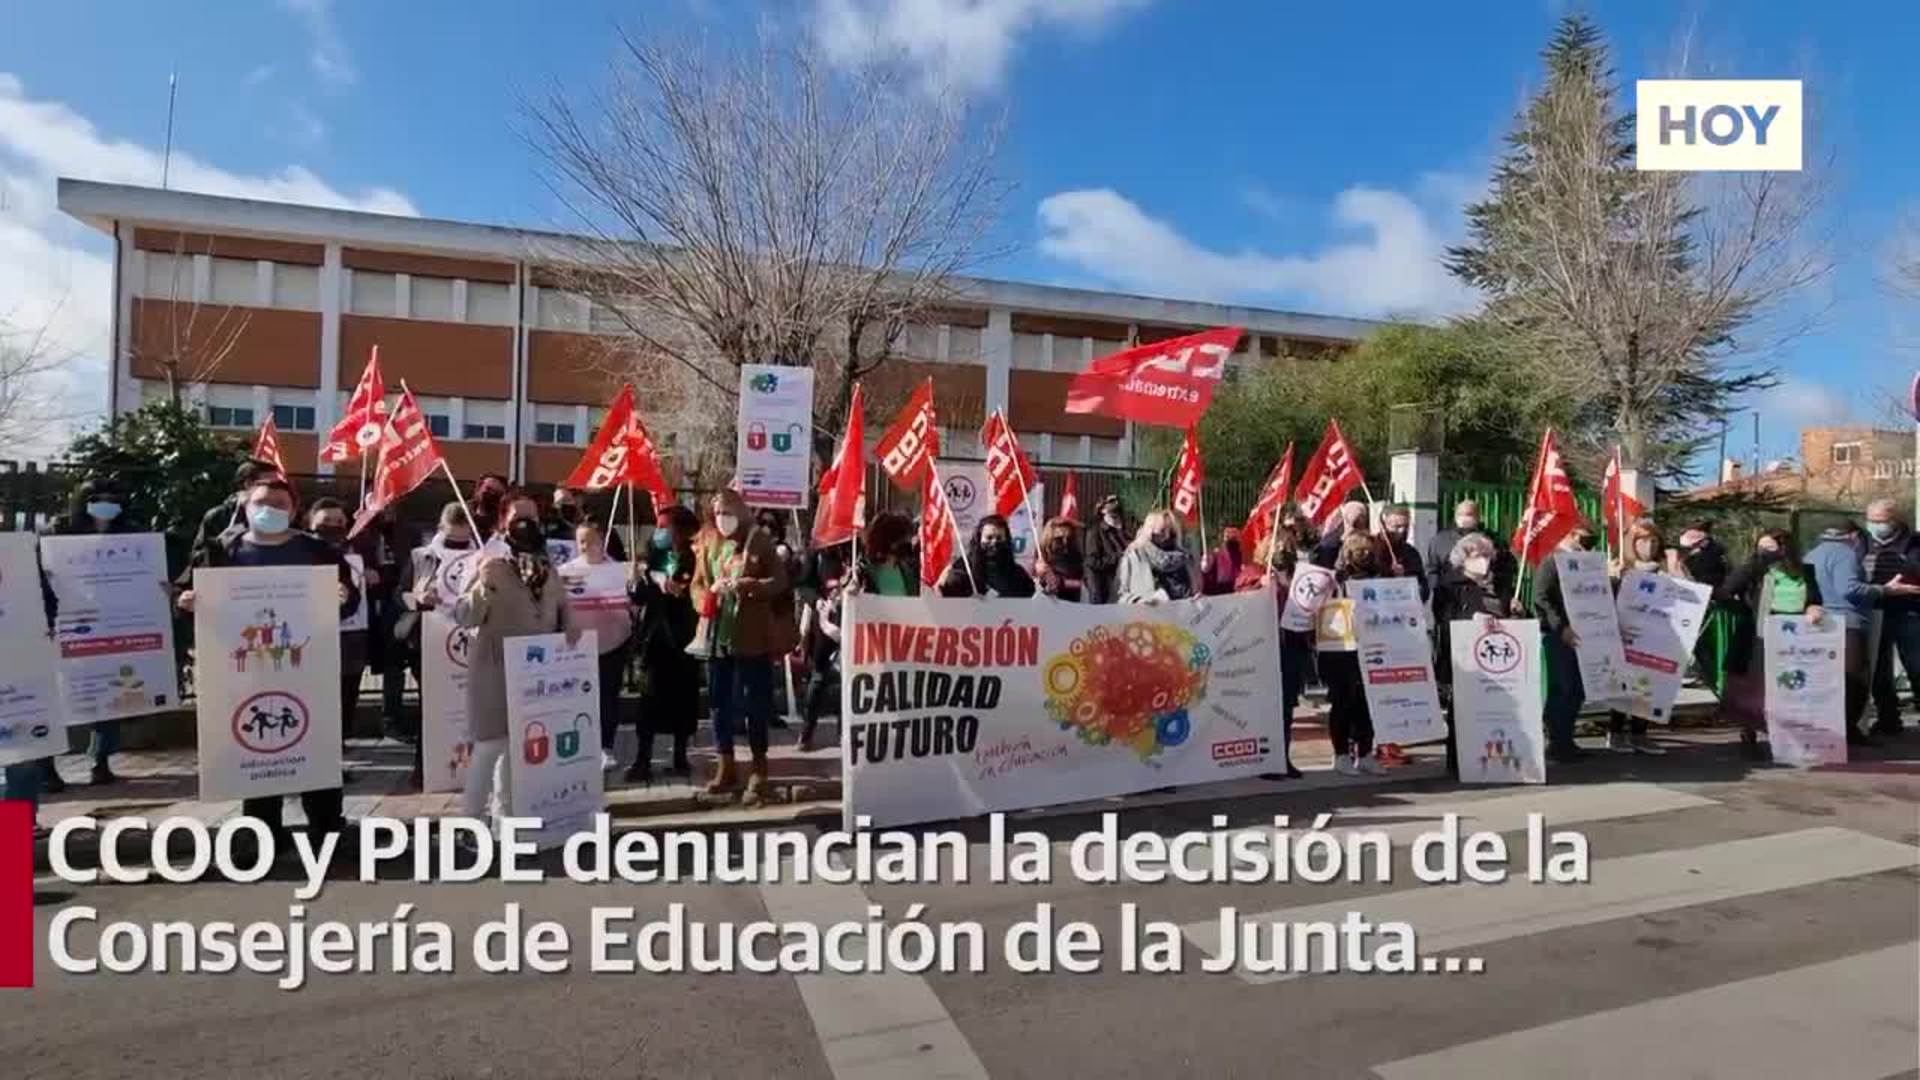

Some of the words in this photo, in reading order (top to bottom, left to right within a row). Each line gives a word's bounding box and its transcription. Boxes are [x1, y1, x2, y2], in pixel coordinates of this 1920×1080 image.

[853, 619, 1040, 667] INVERSIÓN
[850, 671, 1002, 715] CALIDAD
[850, 715, 979, 766] FUTURO
[1214, 741, 1256, 758] CCOO
